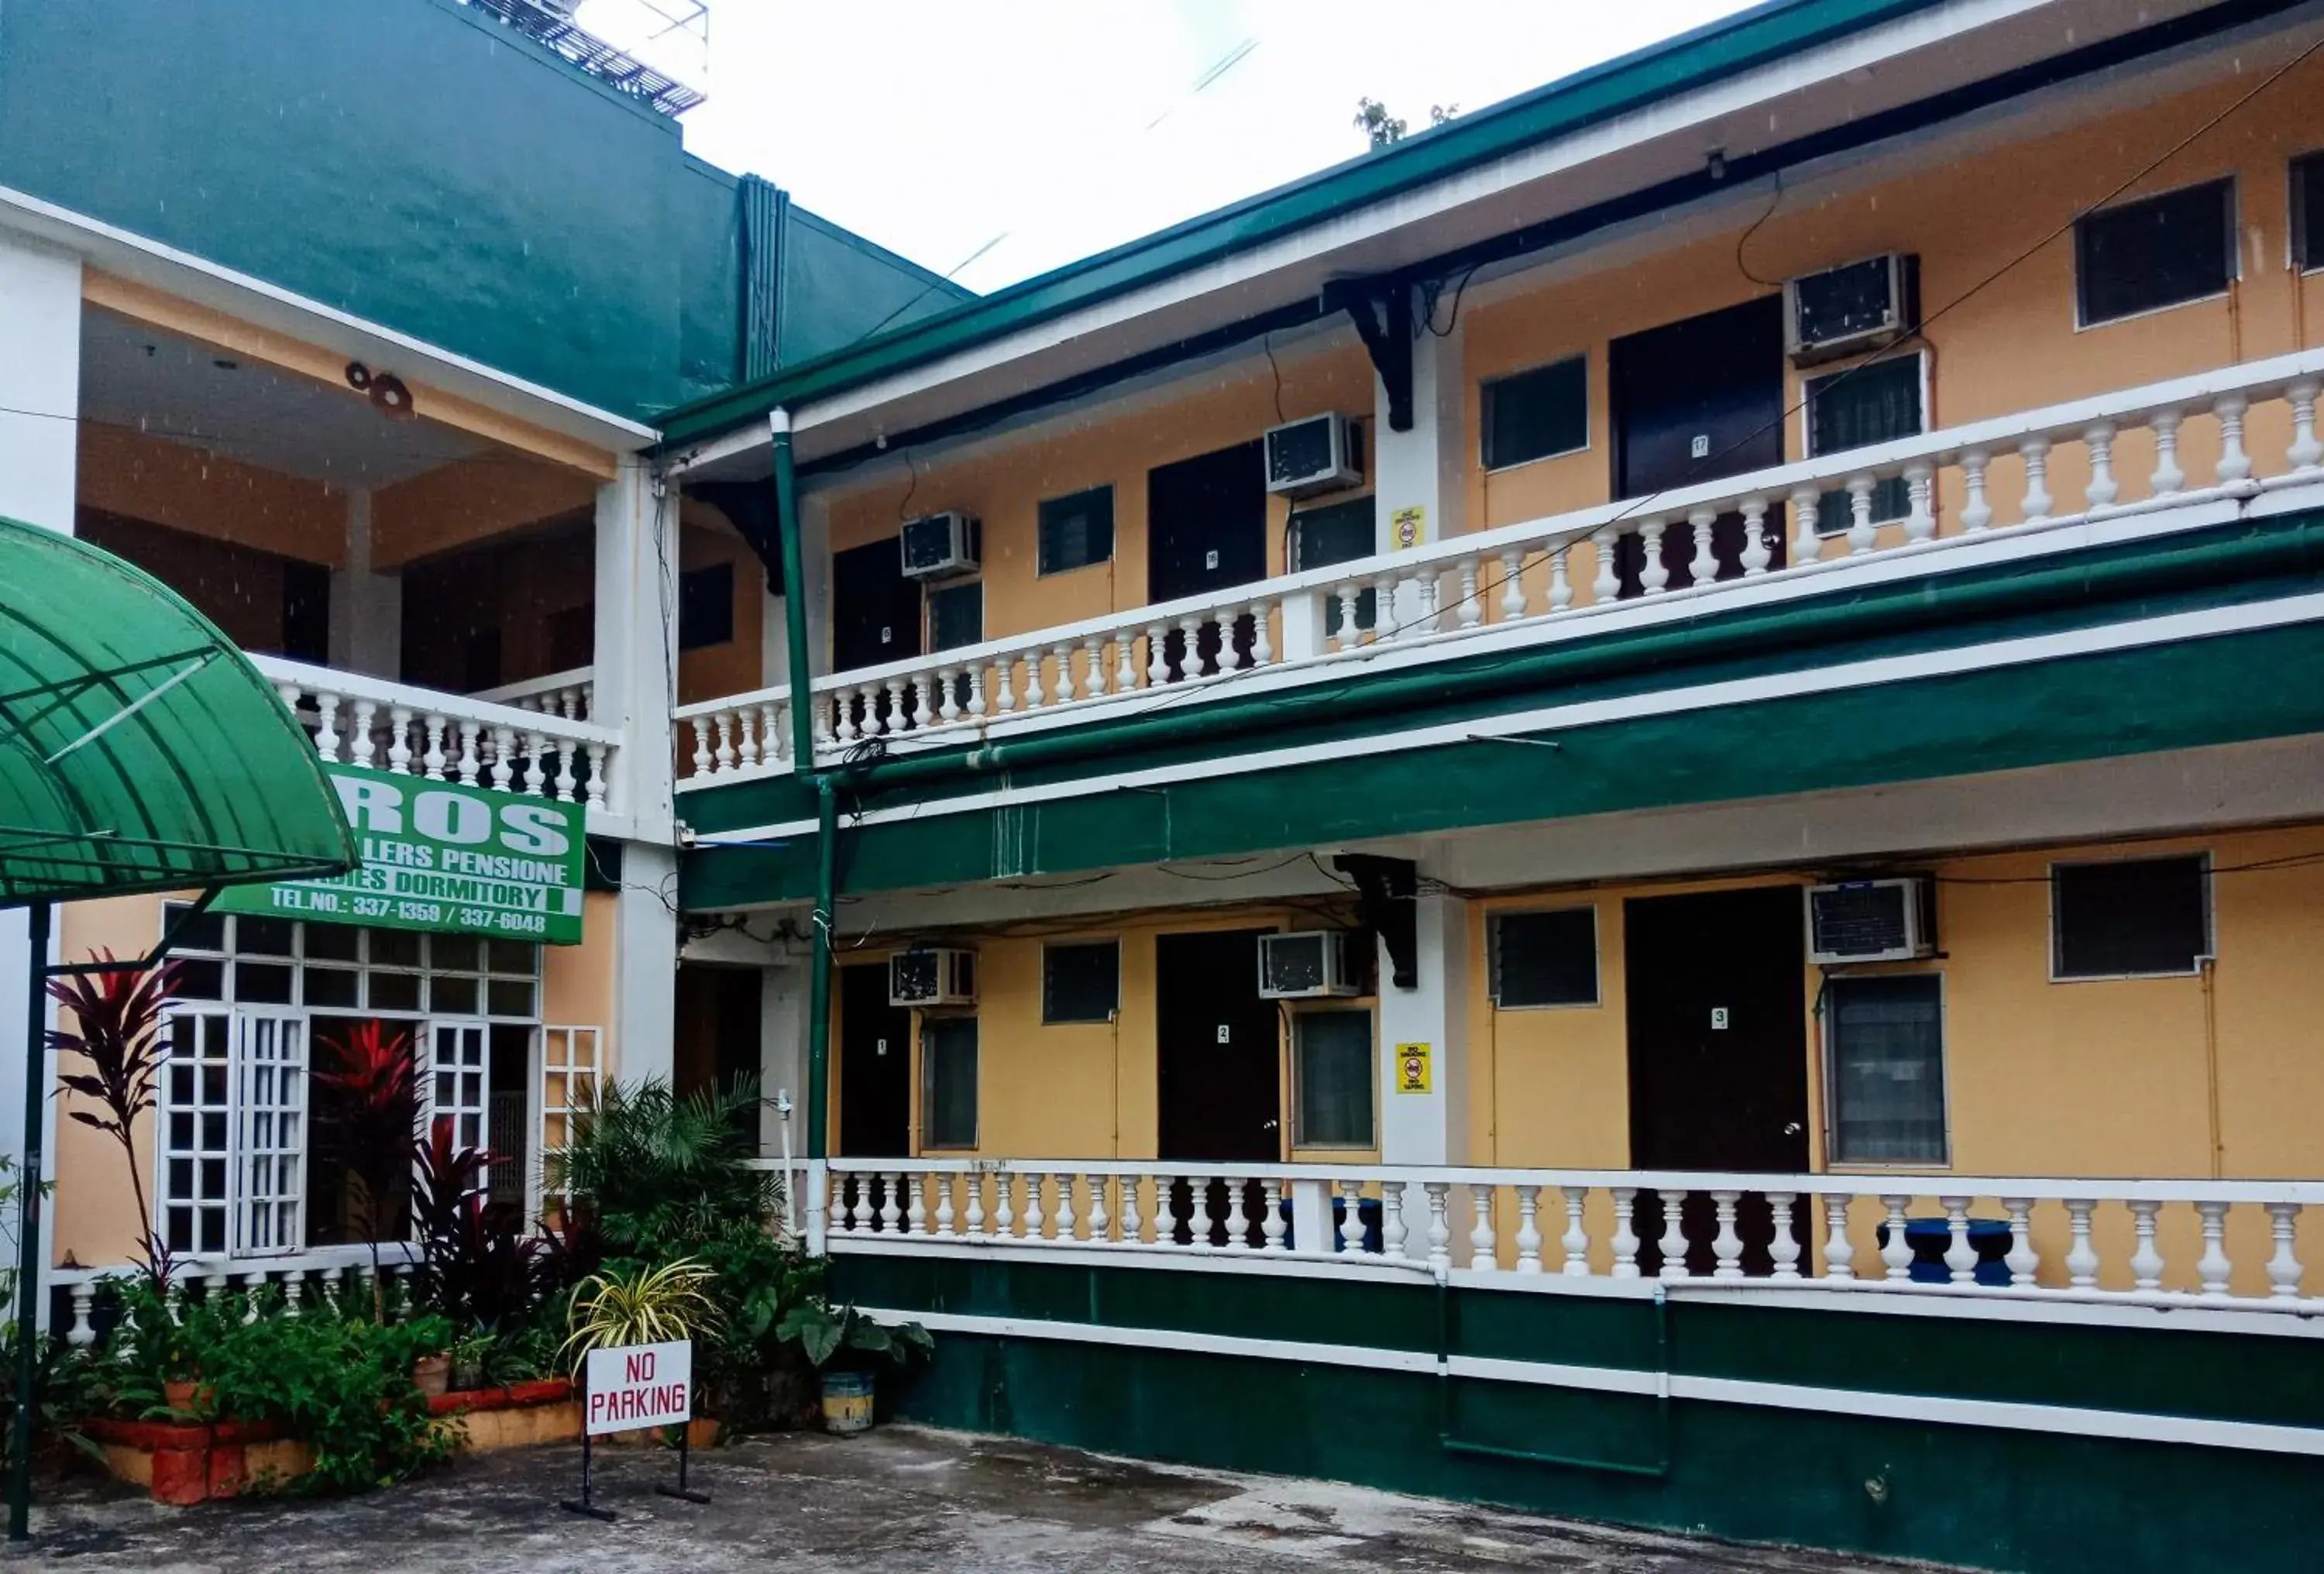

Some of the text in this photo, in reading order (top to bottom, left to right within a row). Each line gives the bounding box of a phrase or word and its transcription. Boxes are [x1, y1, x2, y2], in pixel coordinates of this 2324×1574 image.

[355, 837, 569, 885] LERS PENSIONE
[395, 871, 542, 908] DORMITORY
[352, 896, 440, 923] 337-1359
[460, 907, 546, 933] 337-6048
[627, 1352, 655, 1383] NO
[591, 1383, 686, 1424] PARKING
